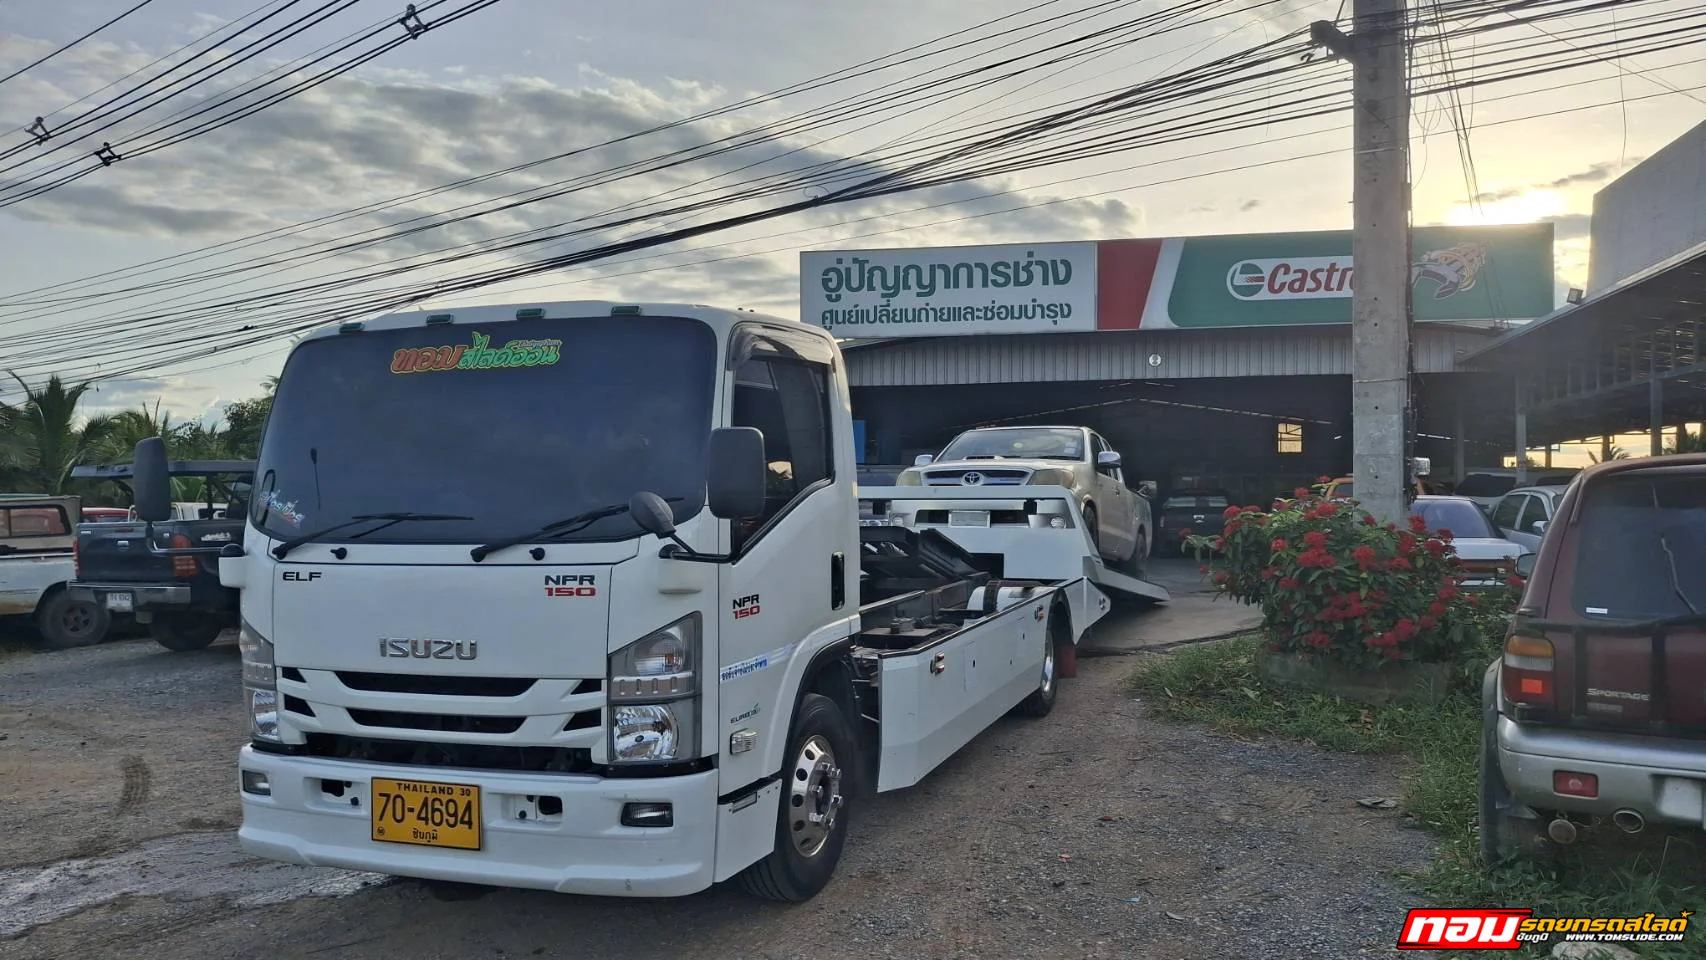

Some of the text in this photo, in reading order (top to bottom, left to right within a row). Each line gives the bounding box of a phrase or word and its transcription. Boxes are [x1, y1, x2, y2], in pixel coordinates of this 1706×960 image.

[821, 251, 1073, 303] อู่ปัญญาการช่าง
[1267, 262, 1354, 295] Castr
[821, 298, 1073, 331] ศูนย์เปลี่ยนถ่ายและซ่อมบำรุง
[282, 571, 322, 582] ELF
[544, 575, 595, 586] NPR
[544, 587, 596, 597] 150
[732, 594, 760, 610] NPR
[732, 605, 760, 620] 150
[380, 638, 477, 661] ISUZU
[396, 782, 454, 796] THAILAND
[378, 792, 473, 830] 70-4694
